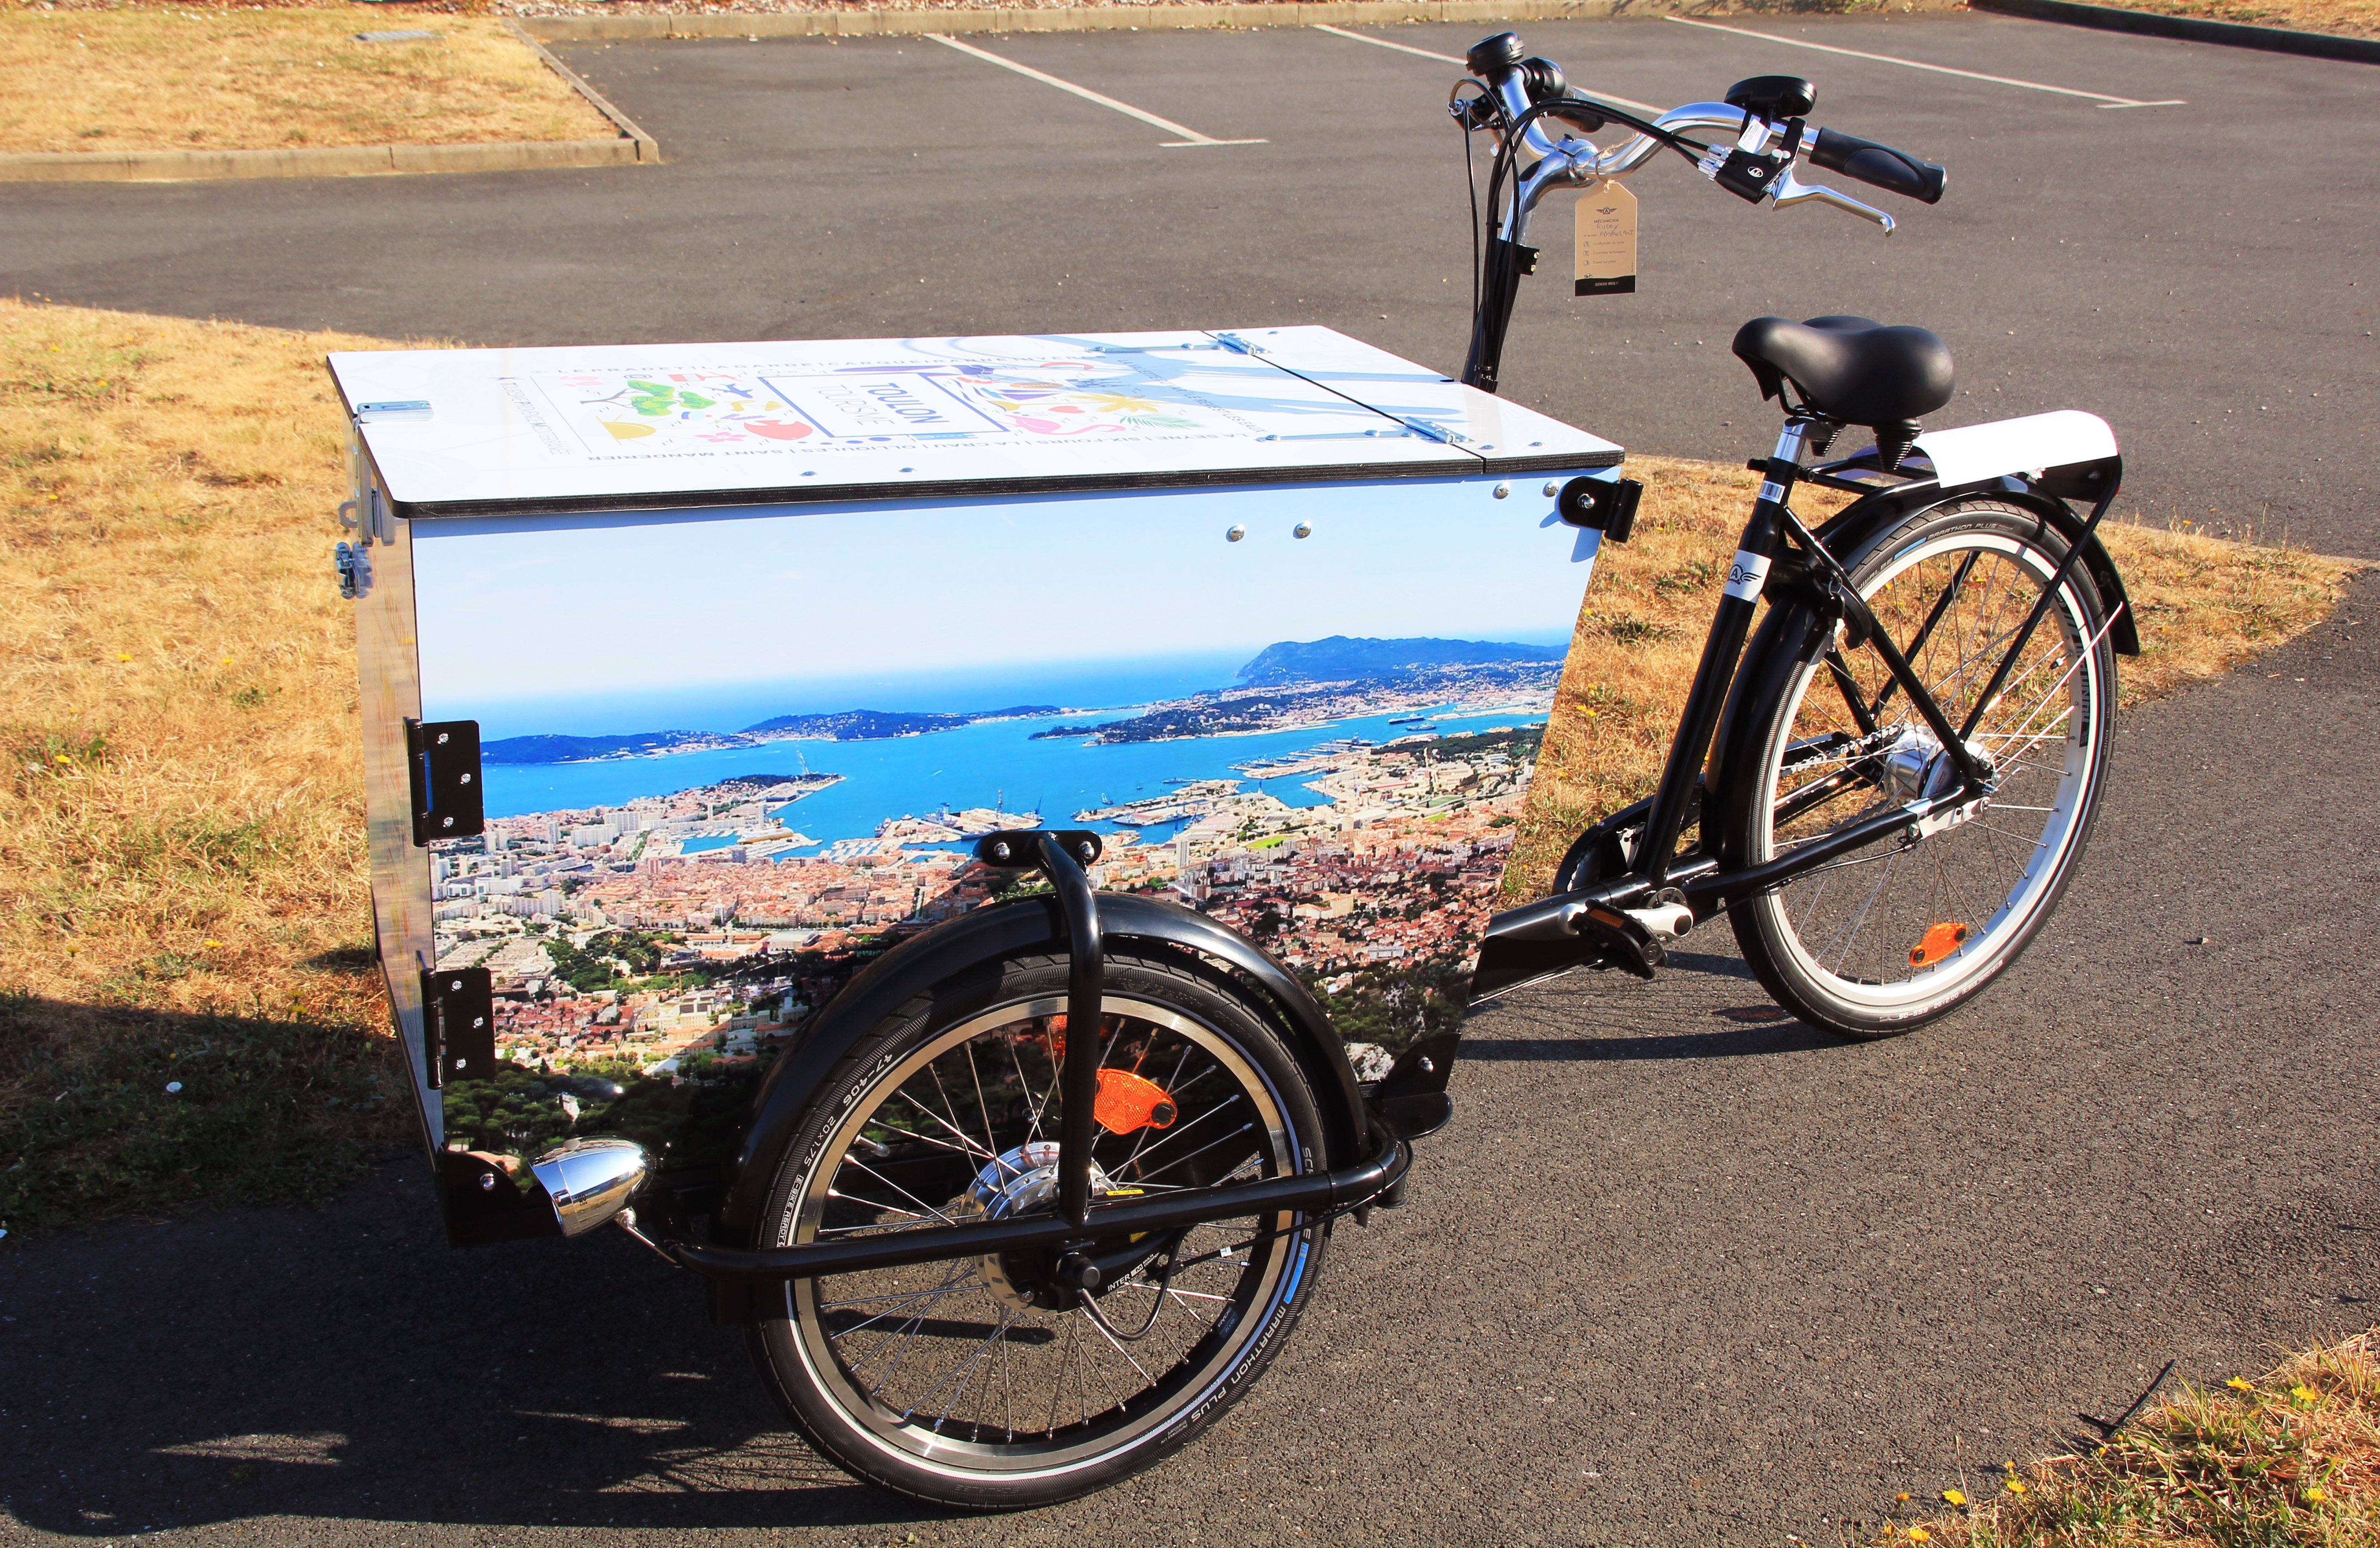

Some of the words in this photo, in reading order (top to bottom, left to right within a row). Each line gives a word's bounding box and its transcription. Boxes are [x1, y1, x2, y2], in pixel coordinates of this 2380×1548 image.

[813, 385, 894, 426] TOURISME
[860, 382, 950, 424] TOULON
[1928, 524, 1972, 540] MARATHON
[1898, 1007, 1928, 1020] 50-559
[842, 1053, 892, 1105] 47-406
[803, 1116, 836, 1167] 20x1.75
[578, 1194, 586, 1203] 20
[787, 1177, 802, 1208] E-BIKE
[1107, 1273, 1131, 1292] INTER
[1230, 1306, 1287, 1385] MARATHON
[1191, 1386, 1227, 1422] PLUS
